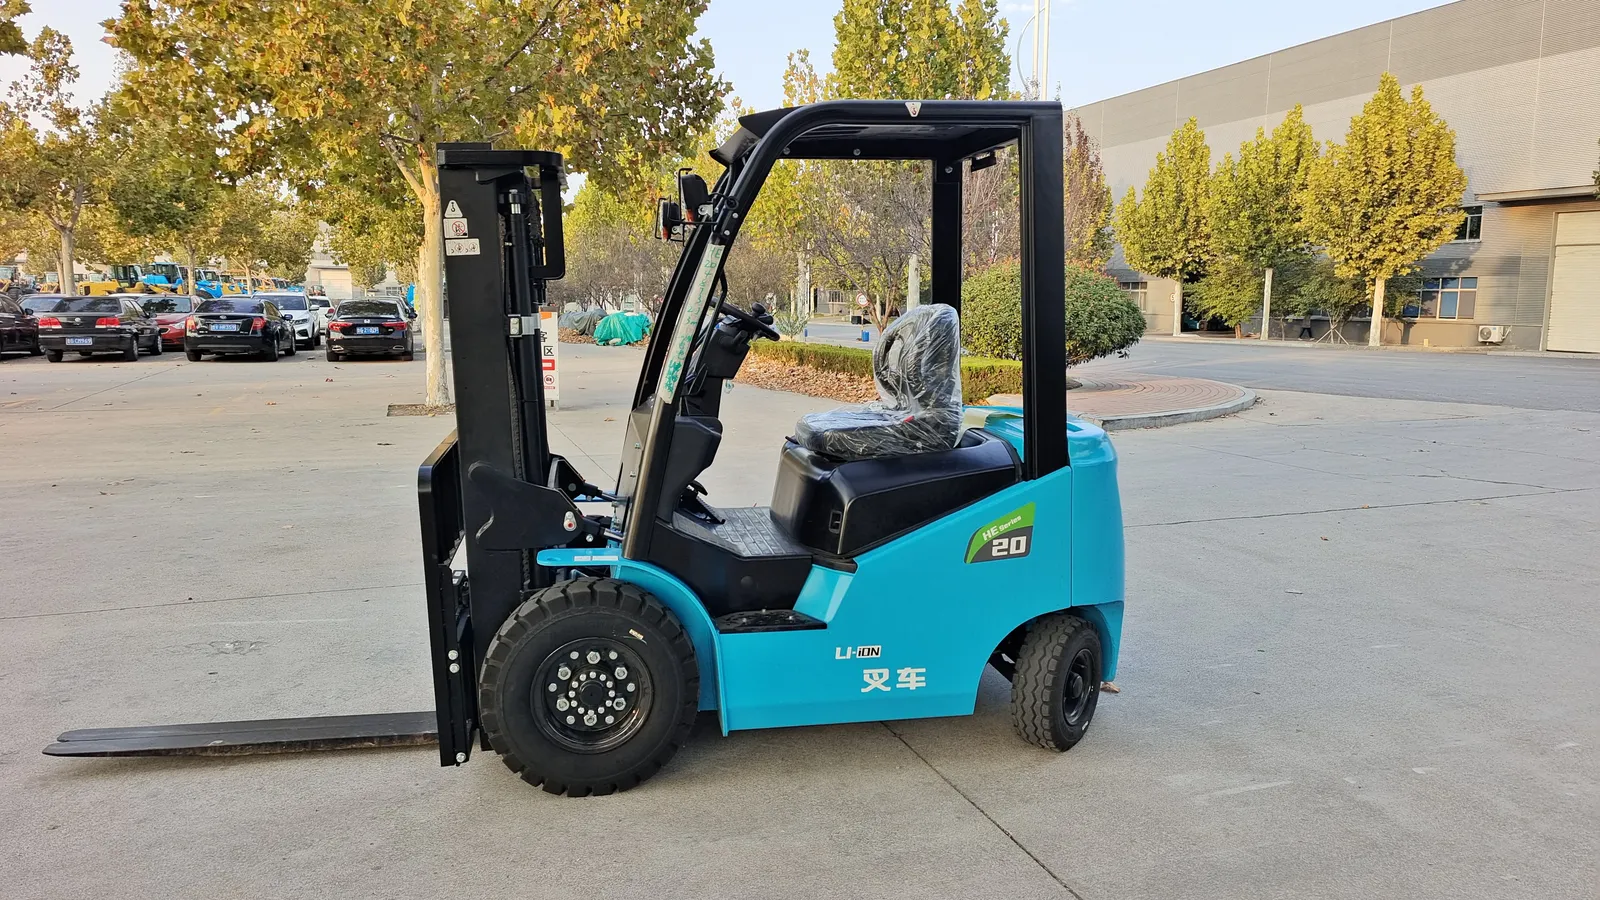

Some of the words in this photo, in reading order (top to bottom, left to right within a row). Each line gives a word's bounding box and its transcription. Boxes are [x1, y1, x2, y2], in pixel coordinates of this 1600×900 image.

[982, 526, 999, 541] HE
[999, 516, 1022, 531] Series
[991, 536, 1027, 557] 20
[861, 667, 927, 692] 叉车
